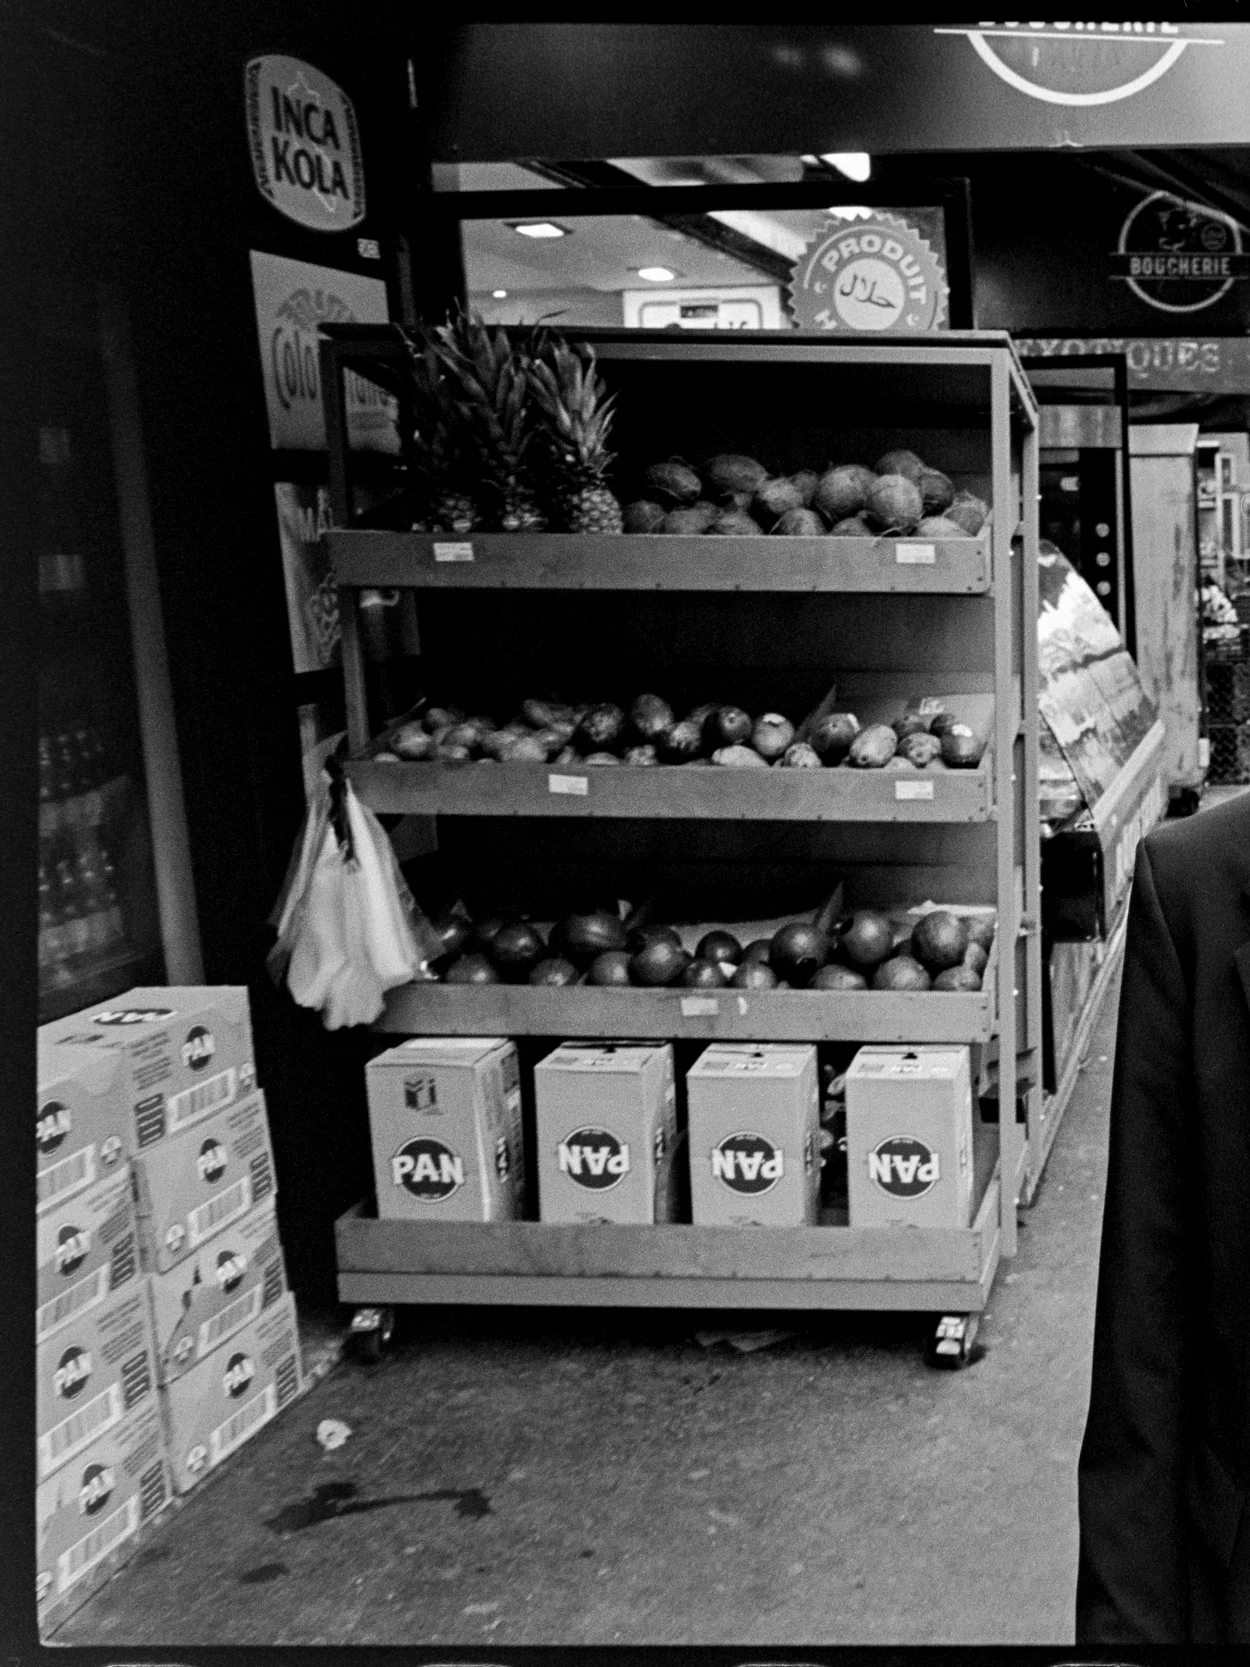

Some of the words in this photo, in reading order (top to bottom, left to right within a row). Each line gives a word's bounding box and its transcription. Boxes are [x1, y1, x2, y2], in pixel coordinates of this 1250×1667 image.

[271, 86, 340, 150] INCA
[272, 136, 350, 200] KOLA
[821, 234, 927, 304] PRODUIT
[1130, 257, 1231, 276] BOUCHERIE
[840, 274, 896, 309] حلال
[181, 1033, 215, 1066] PAN
[196, 1145, 229, 1180] PAN
[392, 1153, 464, 1184] PAN
[558, 1144, 629, 1175] PAN
[712, 1149, 783, 1180] PAN
[868, 1152, 939, 1183] PAN
[55, 1230, 92, 1273] PAN
[216, 1253, 247, 1286] PAN
[53, 1352, 93, 1396] PAN
[222, 1358, 255, 1397] PAN
[79, 1467, 116, 1514] PAN
